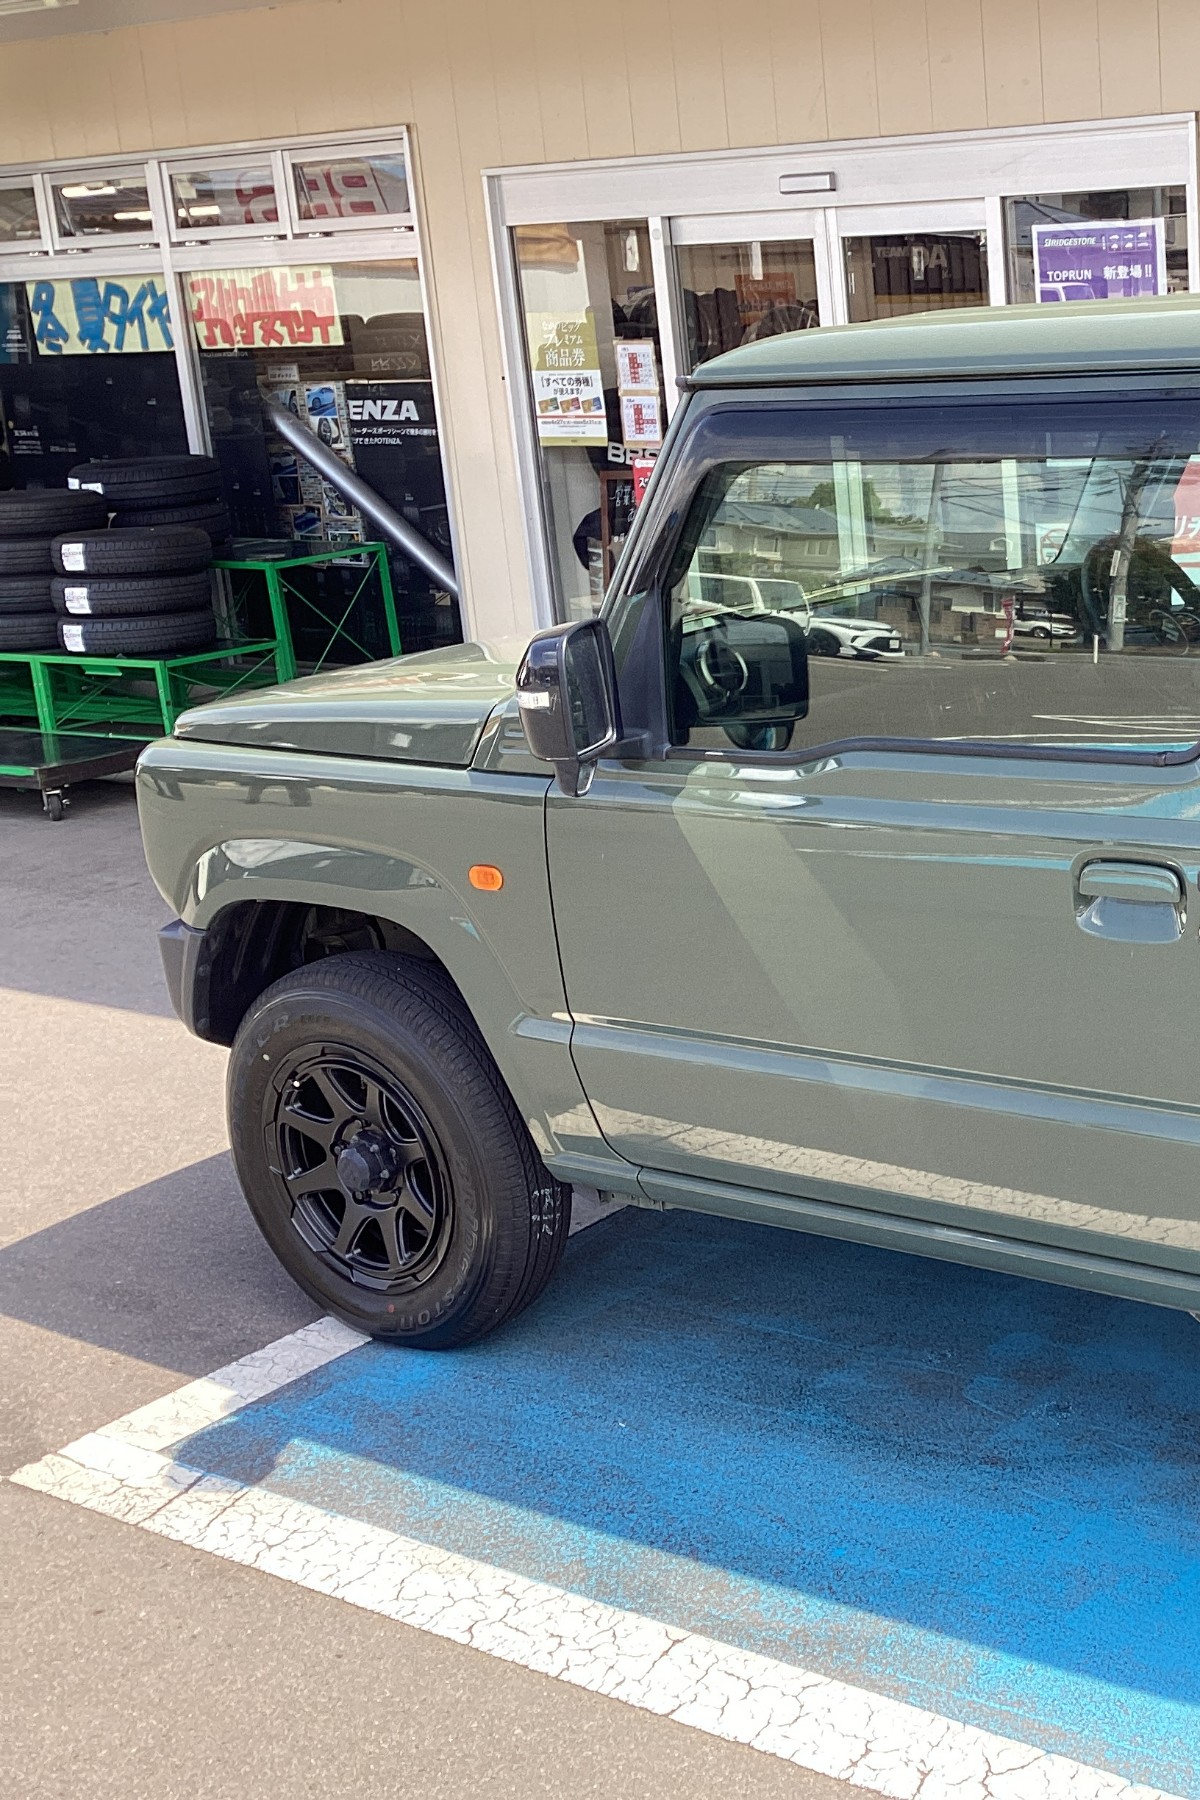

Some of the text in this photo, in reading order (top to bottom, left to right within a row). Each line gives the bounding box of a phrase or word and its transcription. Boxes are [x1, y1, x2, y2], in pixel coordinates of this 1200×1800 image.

[1044, 237, 1097, 247] BRIDGESTONE
[1047, 269, 1092, 281] TOPRUN
[543, 334, 583, 348] プレミアム
[544, 348, 586, 367] 商品券
[347, 399, 420, 421] ENZA
